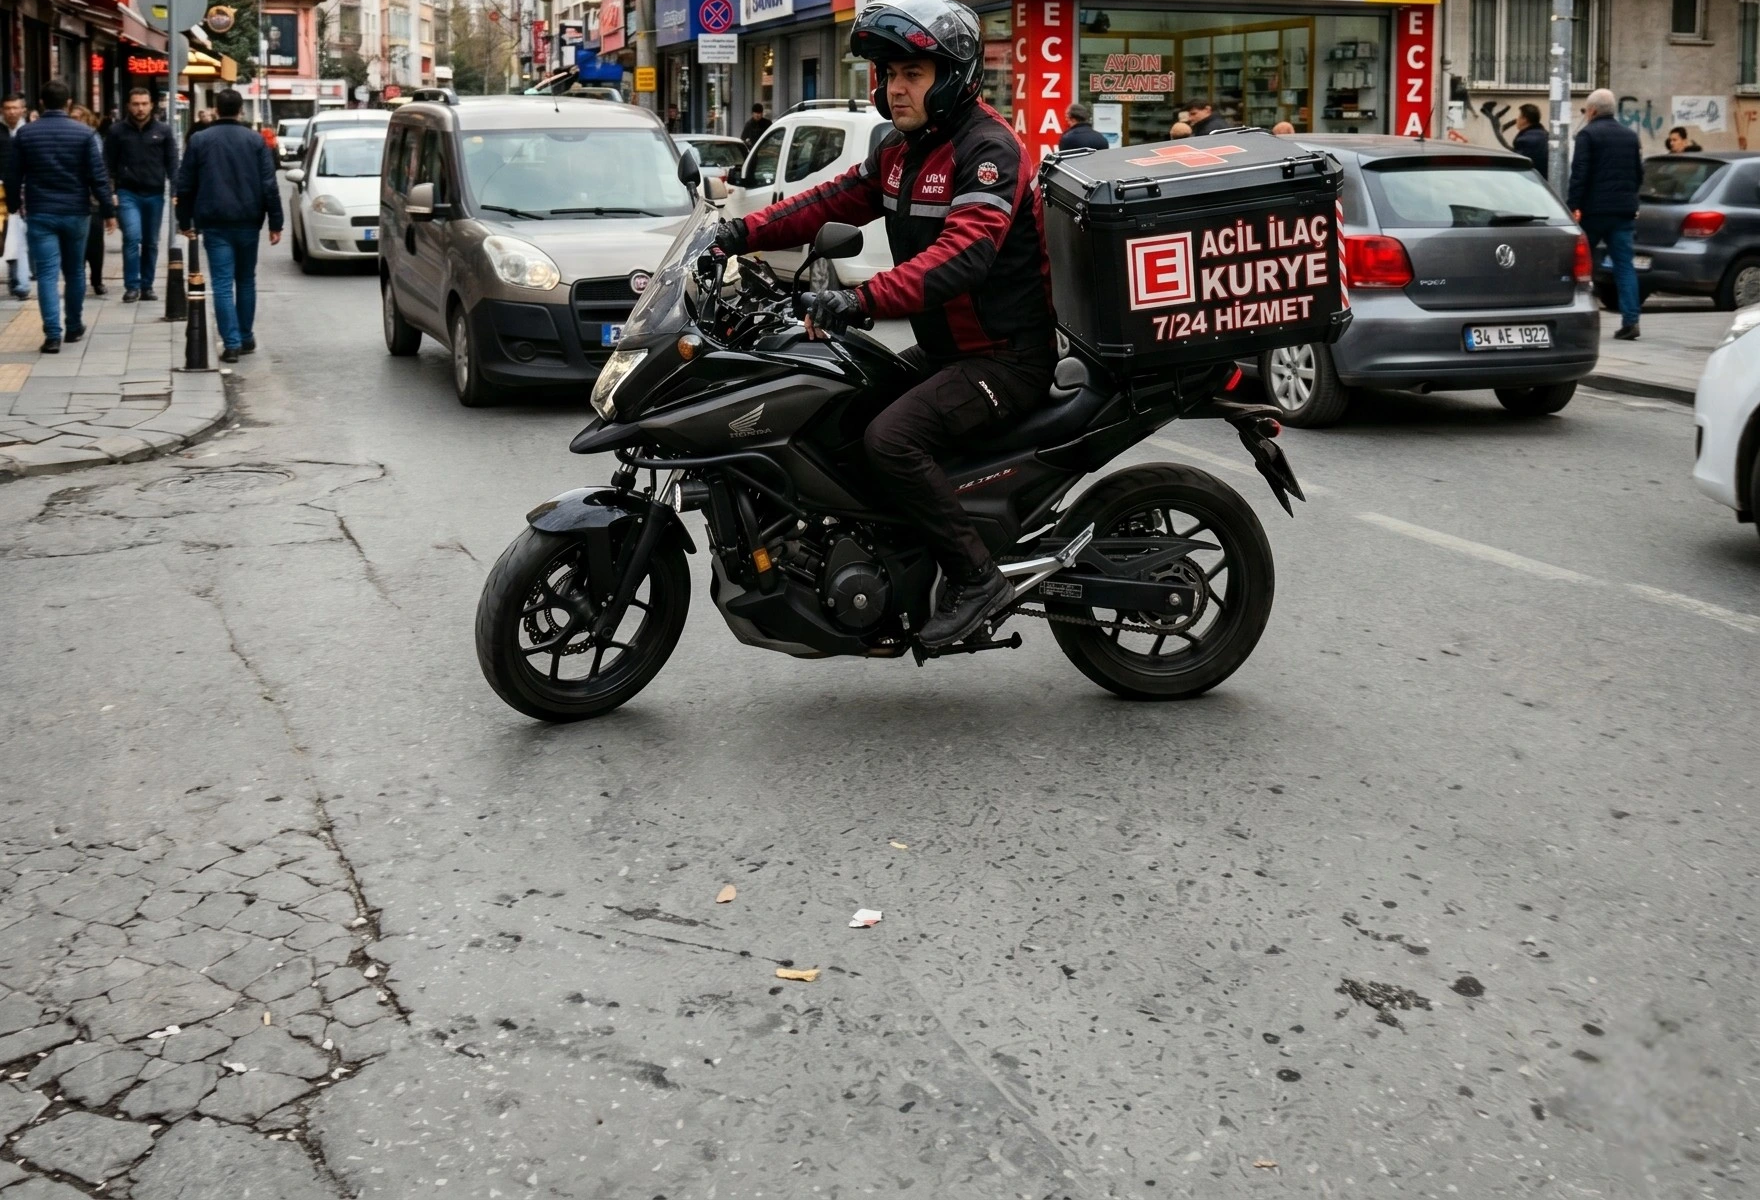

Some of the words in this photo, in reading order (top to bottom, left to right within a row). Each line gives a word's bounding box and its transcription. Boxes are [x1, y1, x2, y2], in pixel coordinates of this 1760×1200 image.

[1090, 71, 1175, 92] ECZANESİ
[1104, 53, 1161, 72] AYDIN
[1200, 219, 1261, 258] ACİL
[1268, 215, 1328, 248] İLAÇ
[1143, 248, 1180, 295] E
[1201, 251, 1328, 301] KURYE
[1152, 310, 1208, 341] 7/24
[1215, 295, 1314, 332] HİZMET
[1473, 328, 1491, 345] 34
[1497, 327, 1514, 344] AE
[1518, 326, 1549, 344] 1922
